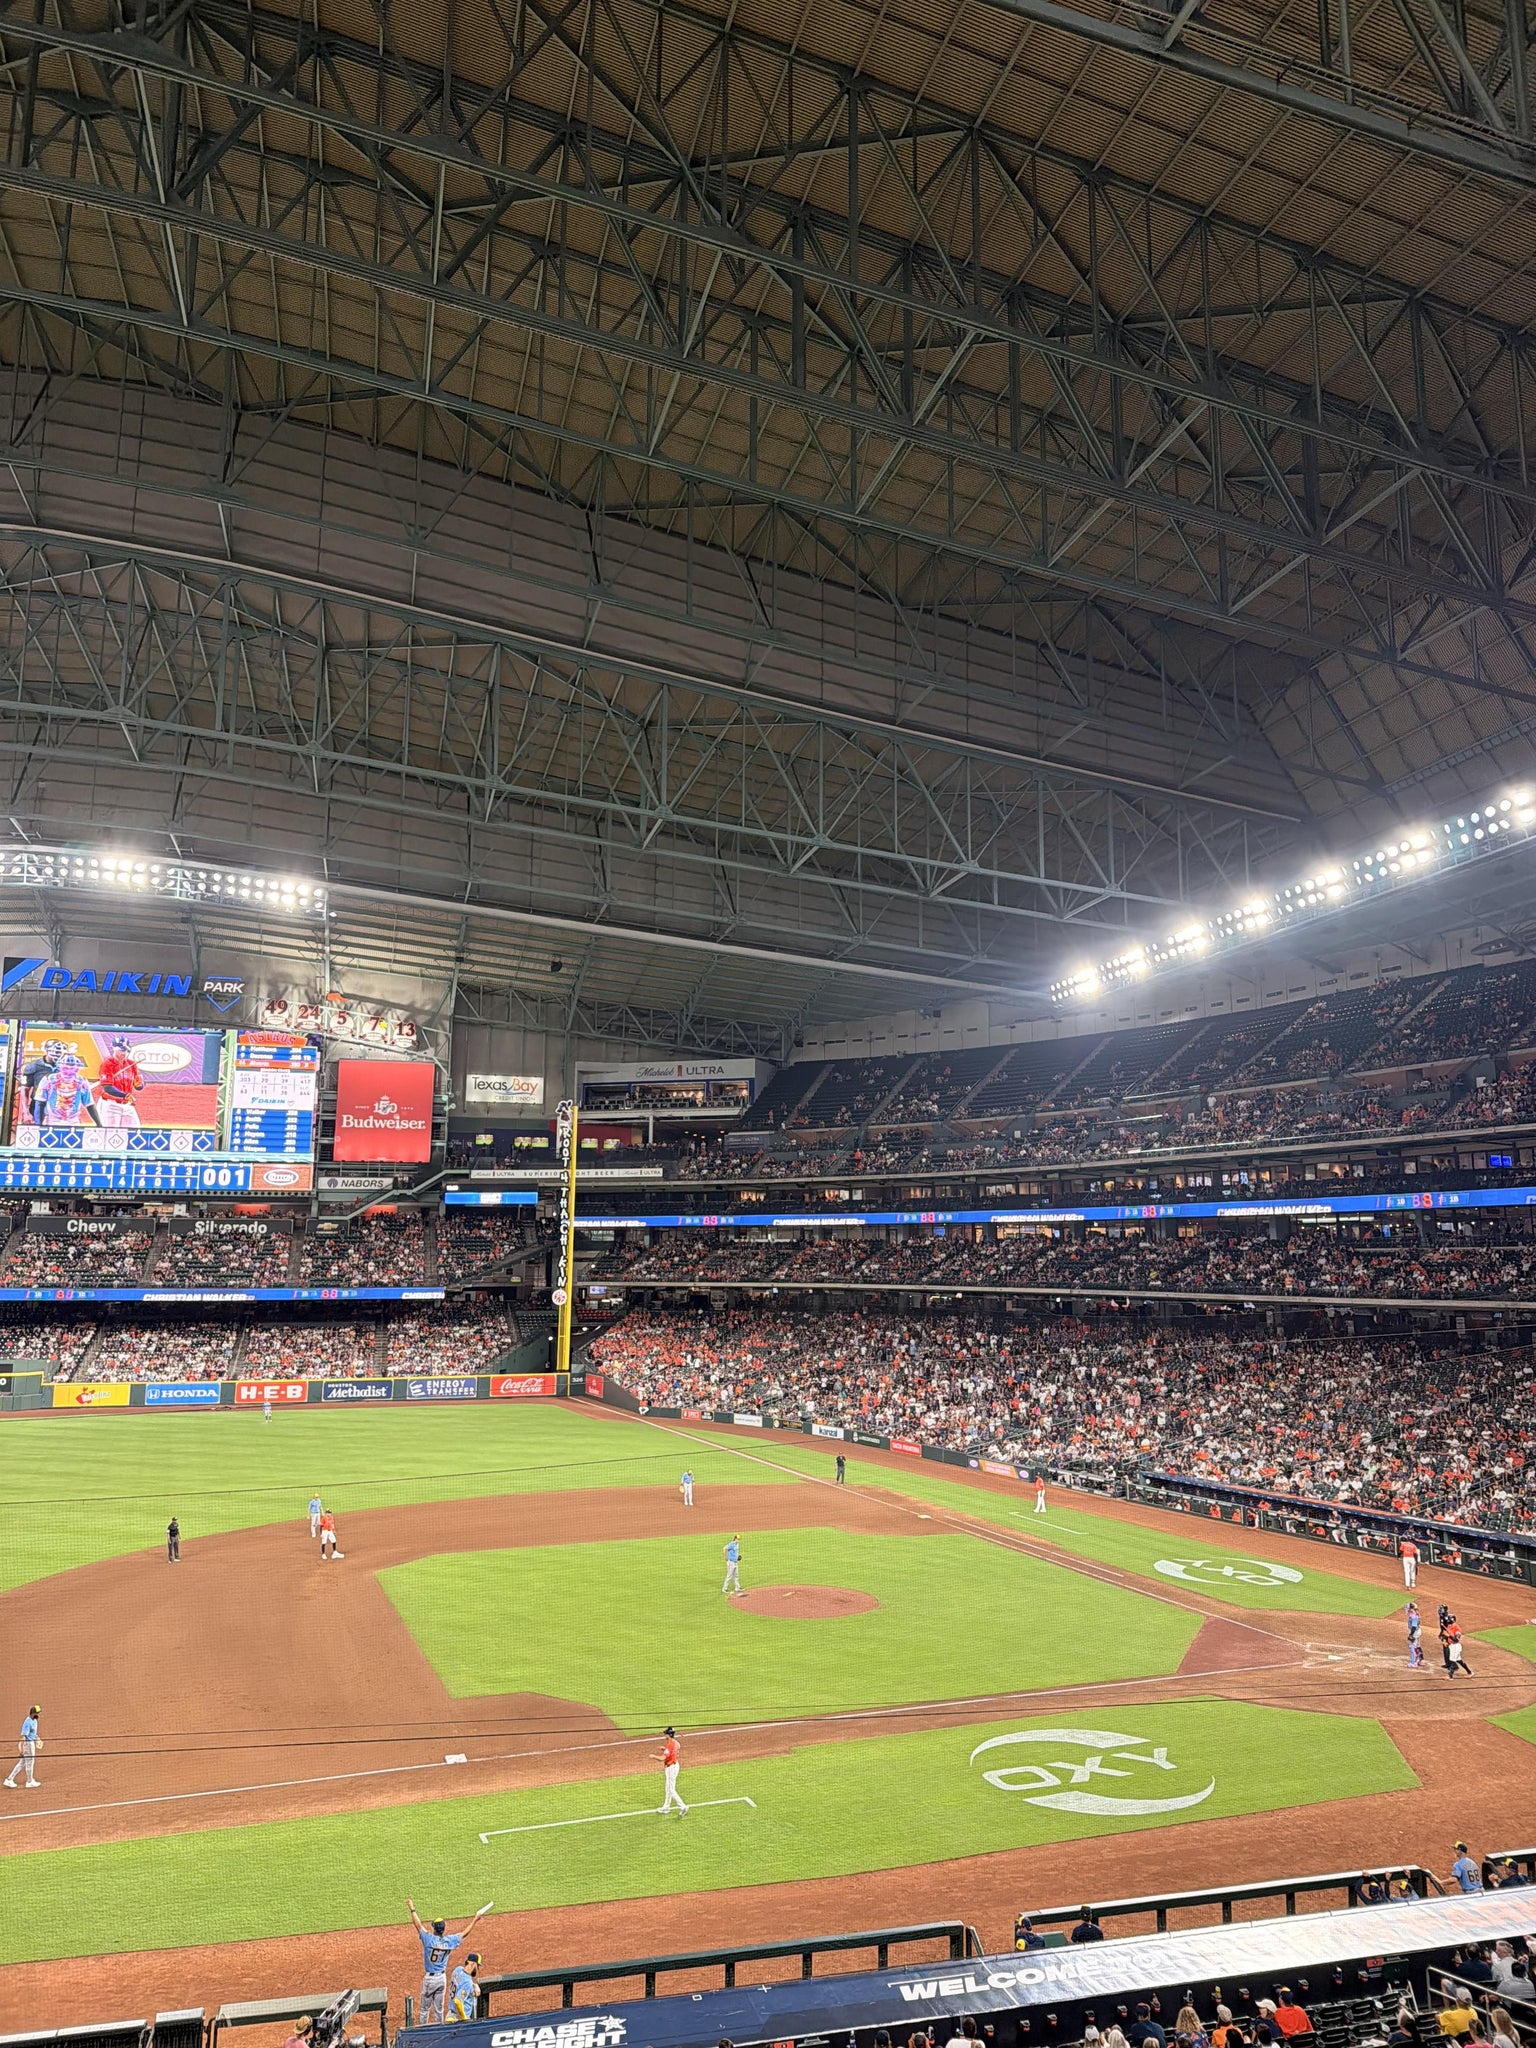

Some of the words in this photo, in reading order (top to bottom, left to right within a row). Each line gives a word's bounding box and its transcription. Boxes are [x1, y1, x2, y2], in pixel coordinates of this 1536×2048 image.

[40, 967, 192, 996] DAIKIN
[203, 981, 245, 994] PARK
[265, 1000, 288, 1015] 49
[298, 1004, 320, 1020] 24
[337, 1011, 347, 1025] 5
[369, 1016, 381, 1031] 7
[397, 1022, 415, 1037] 13
[686, 1066, 724, 1076] ULTRA
[472, 1077, 507, 1091] Texas
[513, 1078, 538, 1095] Bay
[373, 1100, 398, 1115] 150
[561, 1126, 572, 1168] ROOT
[341, 1177, 384, 1188] NABORS
[559, 1171, 569, 1183] 4
[557, 1223, 569, 1288] CHIKIN
[426, 1379, 466, 1388] ENERGY
[427, 1387, 475, 1395] TRANSFER
[162, 1389, 218, 1398] HONDA
[327, 1385, 388, 1398] Methodist
[982, 1747, 1177, 1791] OXY
[1467, 1869, 1480, 1883] 68
[430, 1947, 451, 1963] 67
[899, 1962, 1102, 2002] WELCOME
[491, 2021, 597, 2047] CHASE
